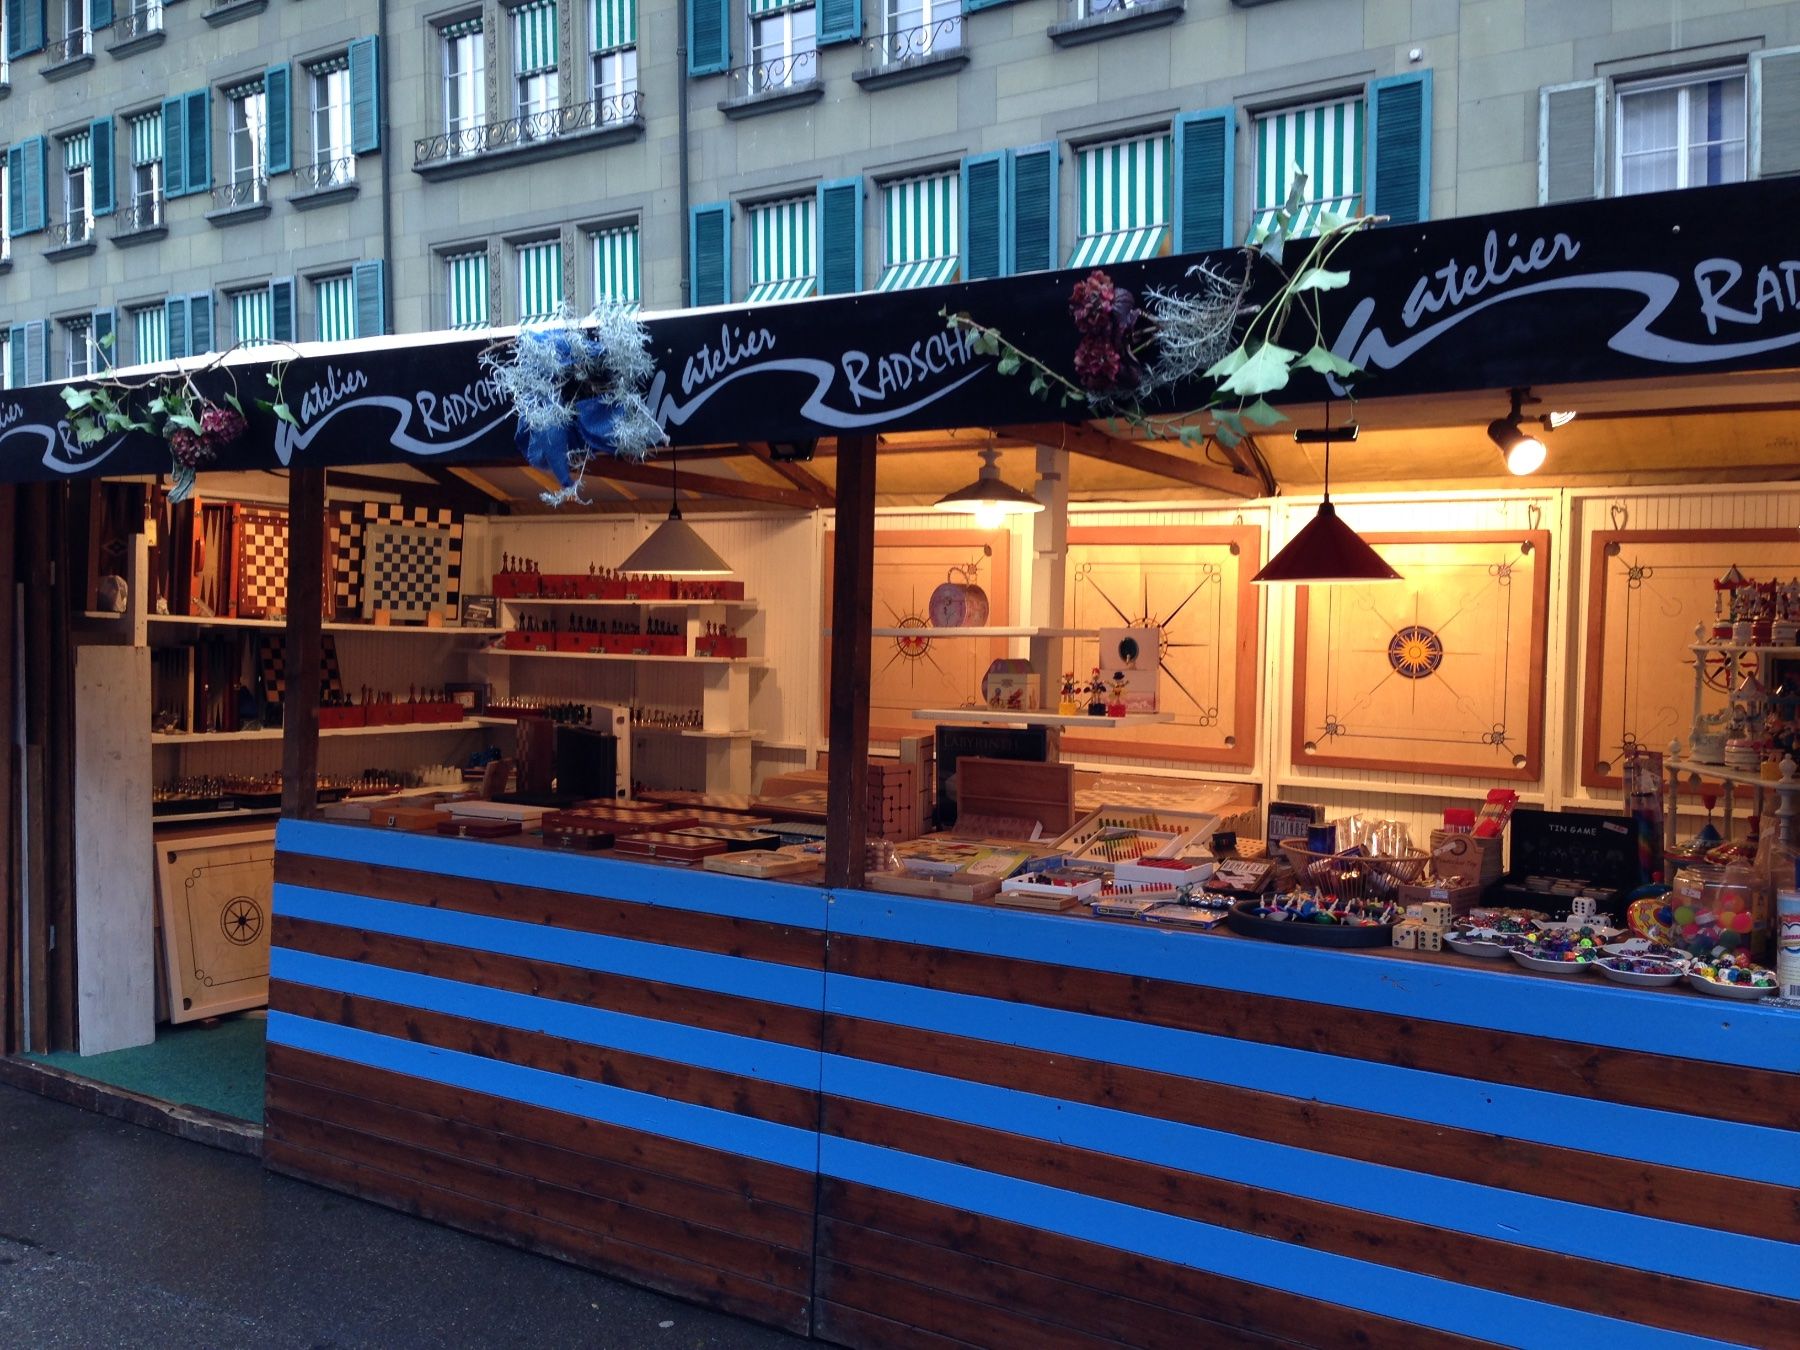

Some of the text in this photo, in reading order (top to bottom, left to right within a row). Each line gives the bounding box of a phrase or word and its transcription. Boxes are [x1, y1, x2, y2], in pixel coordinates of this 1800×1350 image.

[1401, 230, 1581, 328] atelier
[681, 323, 776, 395] atelier
[301, 365, 368, 425] atelier
[1548, 823, 1598, 837] TIN GAME
